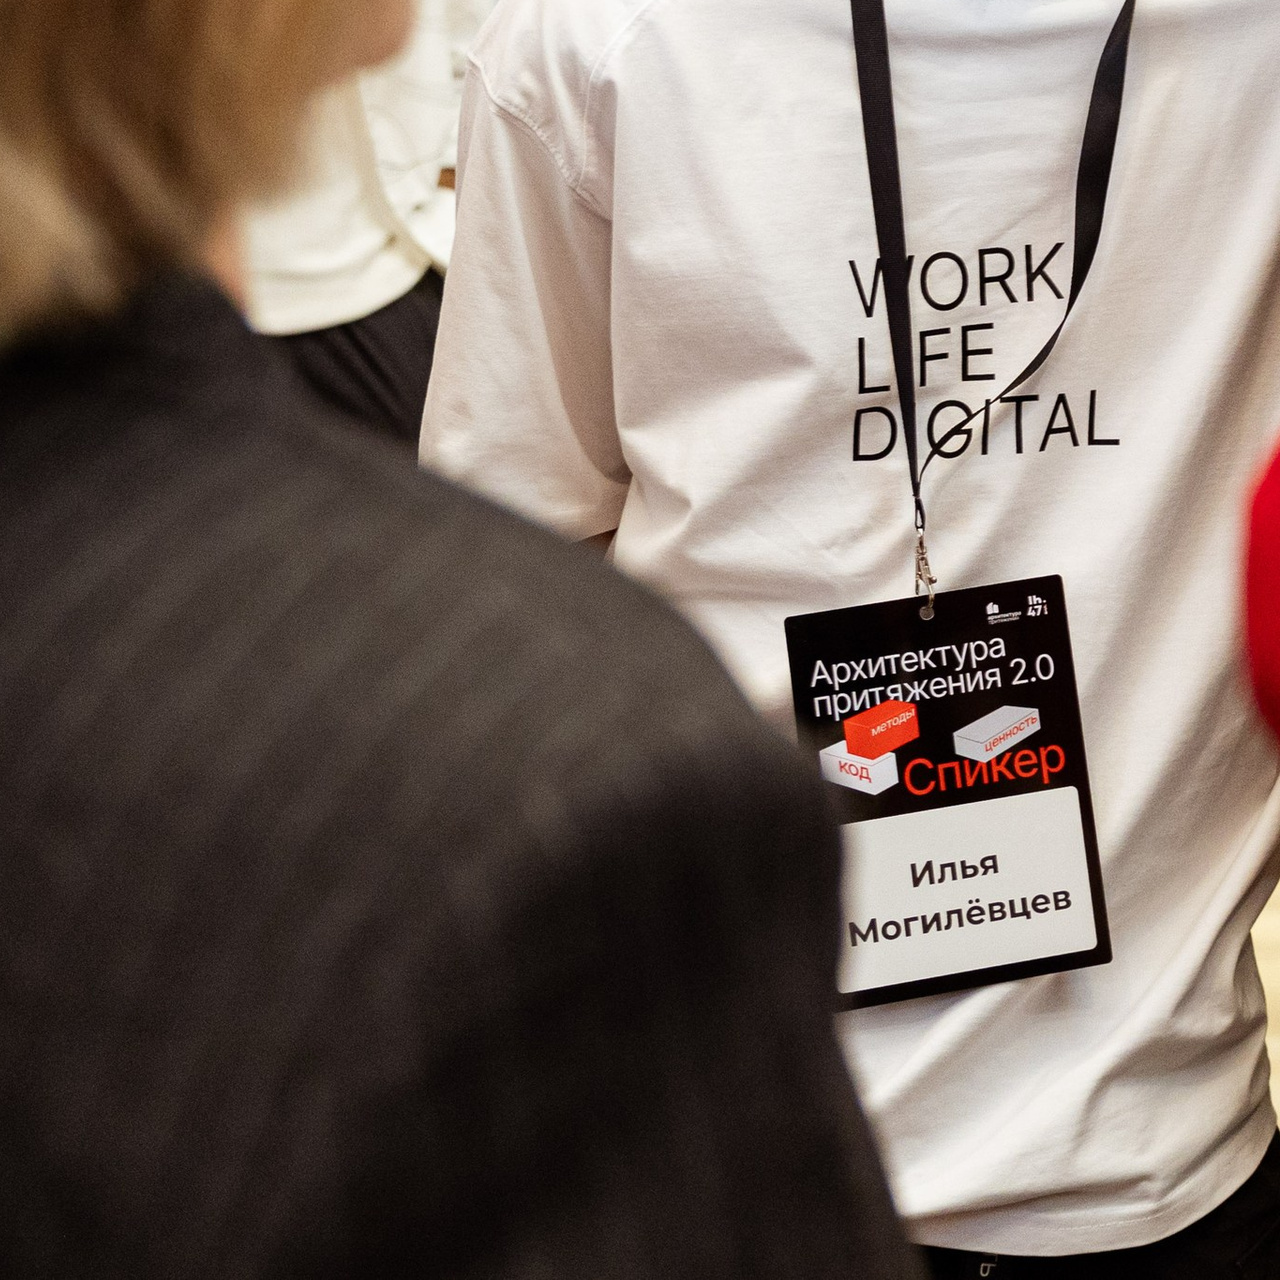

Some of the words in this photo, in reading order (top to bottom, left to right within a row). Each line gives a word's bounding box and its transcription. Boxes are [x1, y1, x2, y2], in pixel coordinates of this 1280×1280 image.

[858, 322, 996, 395] LFE
[852, 389, 1120, 462] DGITAL
[810, 637, 1006, 691] Архитектура
[813, 668, 1002, 722] притяжения
[1009, 653, 1055, 687] 2.0
[870, 707, 915, 737] методы
[984, 714, 1038, 753] ценность
[903, 744, 1066, 797] Спикер
[909, 854, 1000, 888] Илья
[847, 889, 1073, 948] Могилёвцев
